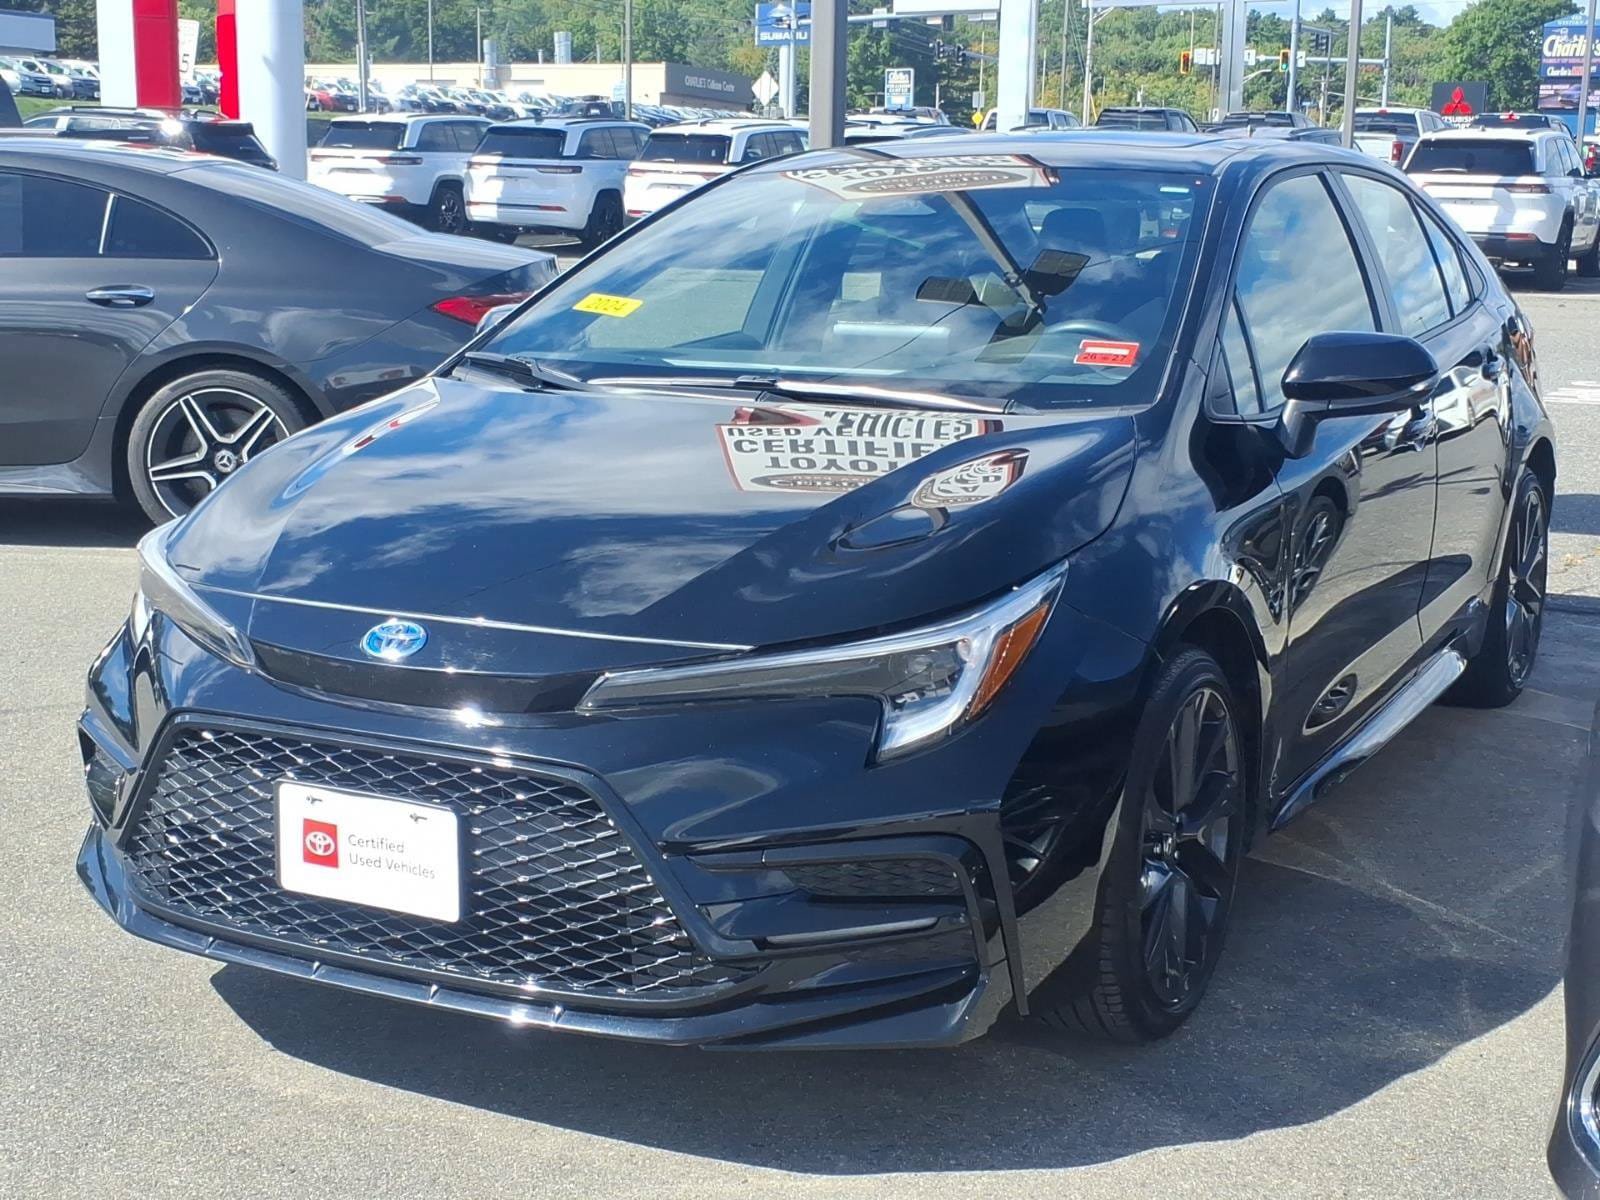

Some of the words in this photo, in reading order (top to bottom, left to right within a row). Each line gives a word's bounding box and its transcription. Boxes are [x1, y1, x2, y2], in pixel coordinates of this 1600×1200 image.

[1543, 34, 1600, 57] Charli's
[348, 834, 405, 854] Certified
[349, 853, 382, 869] Used
[385, 858, 436, 880] Vehicles
